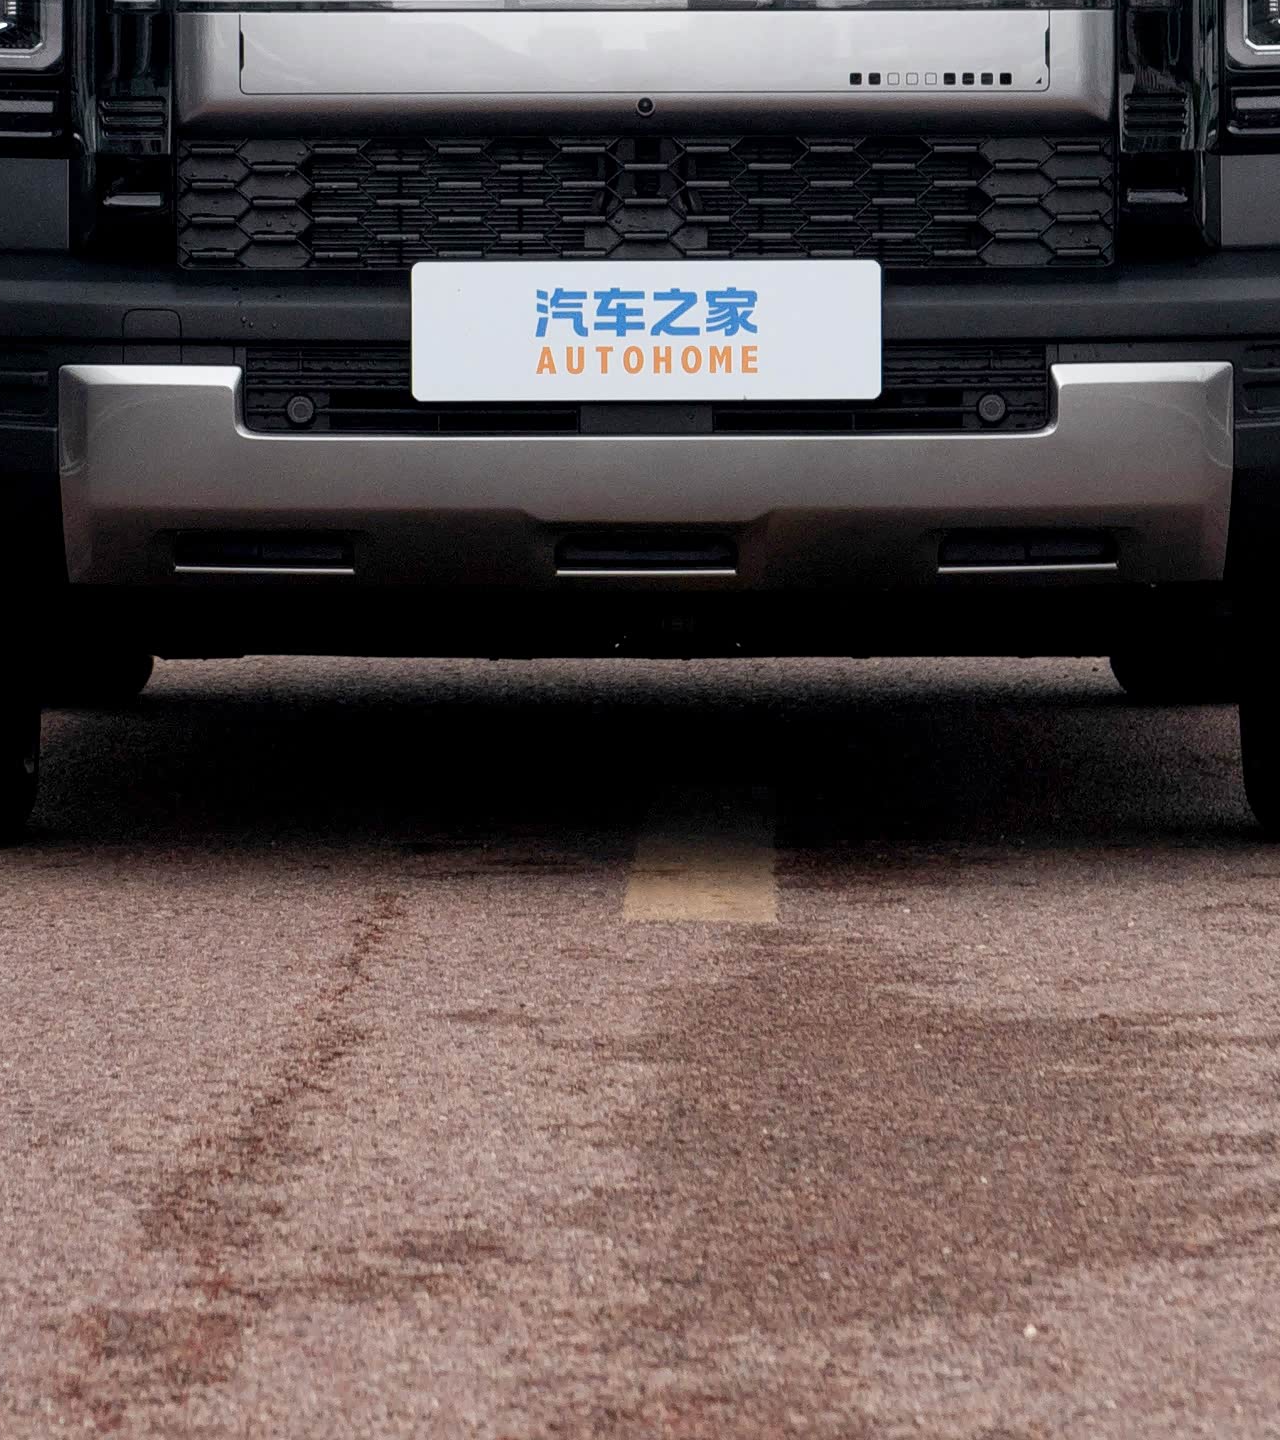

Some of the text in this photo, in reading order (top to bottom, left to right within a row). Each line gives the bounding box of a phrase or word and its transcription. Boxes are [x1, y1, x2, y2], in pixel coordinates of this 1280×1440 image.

[535, 287, 758, 337] 汽车之家
[535, 345, 758, 375] AUTOHOME
